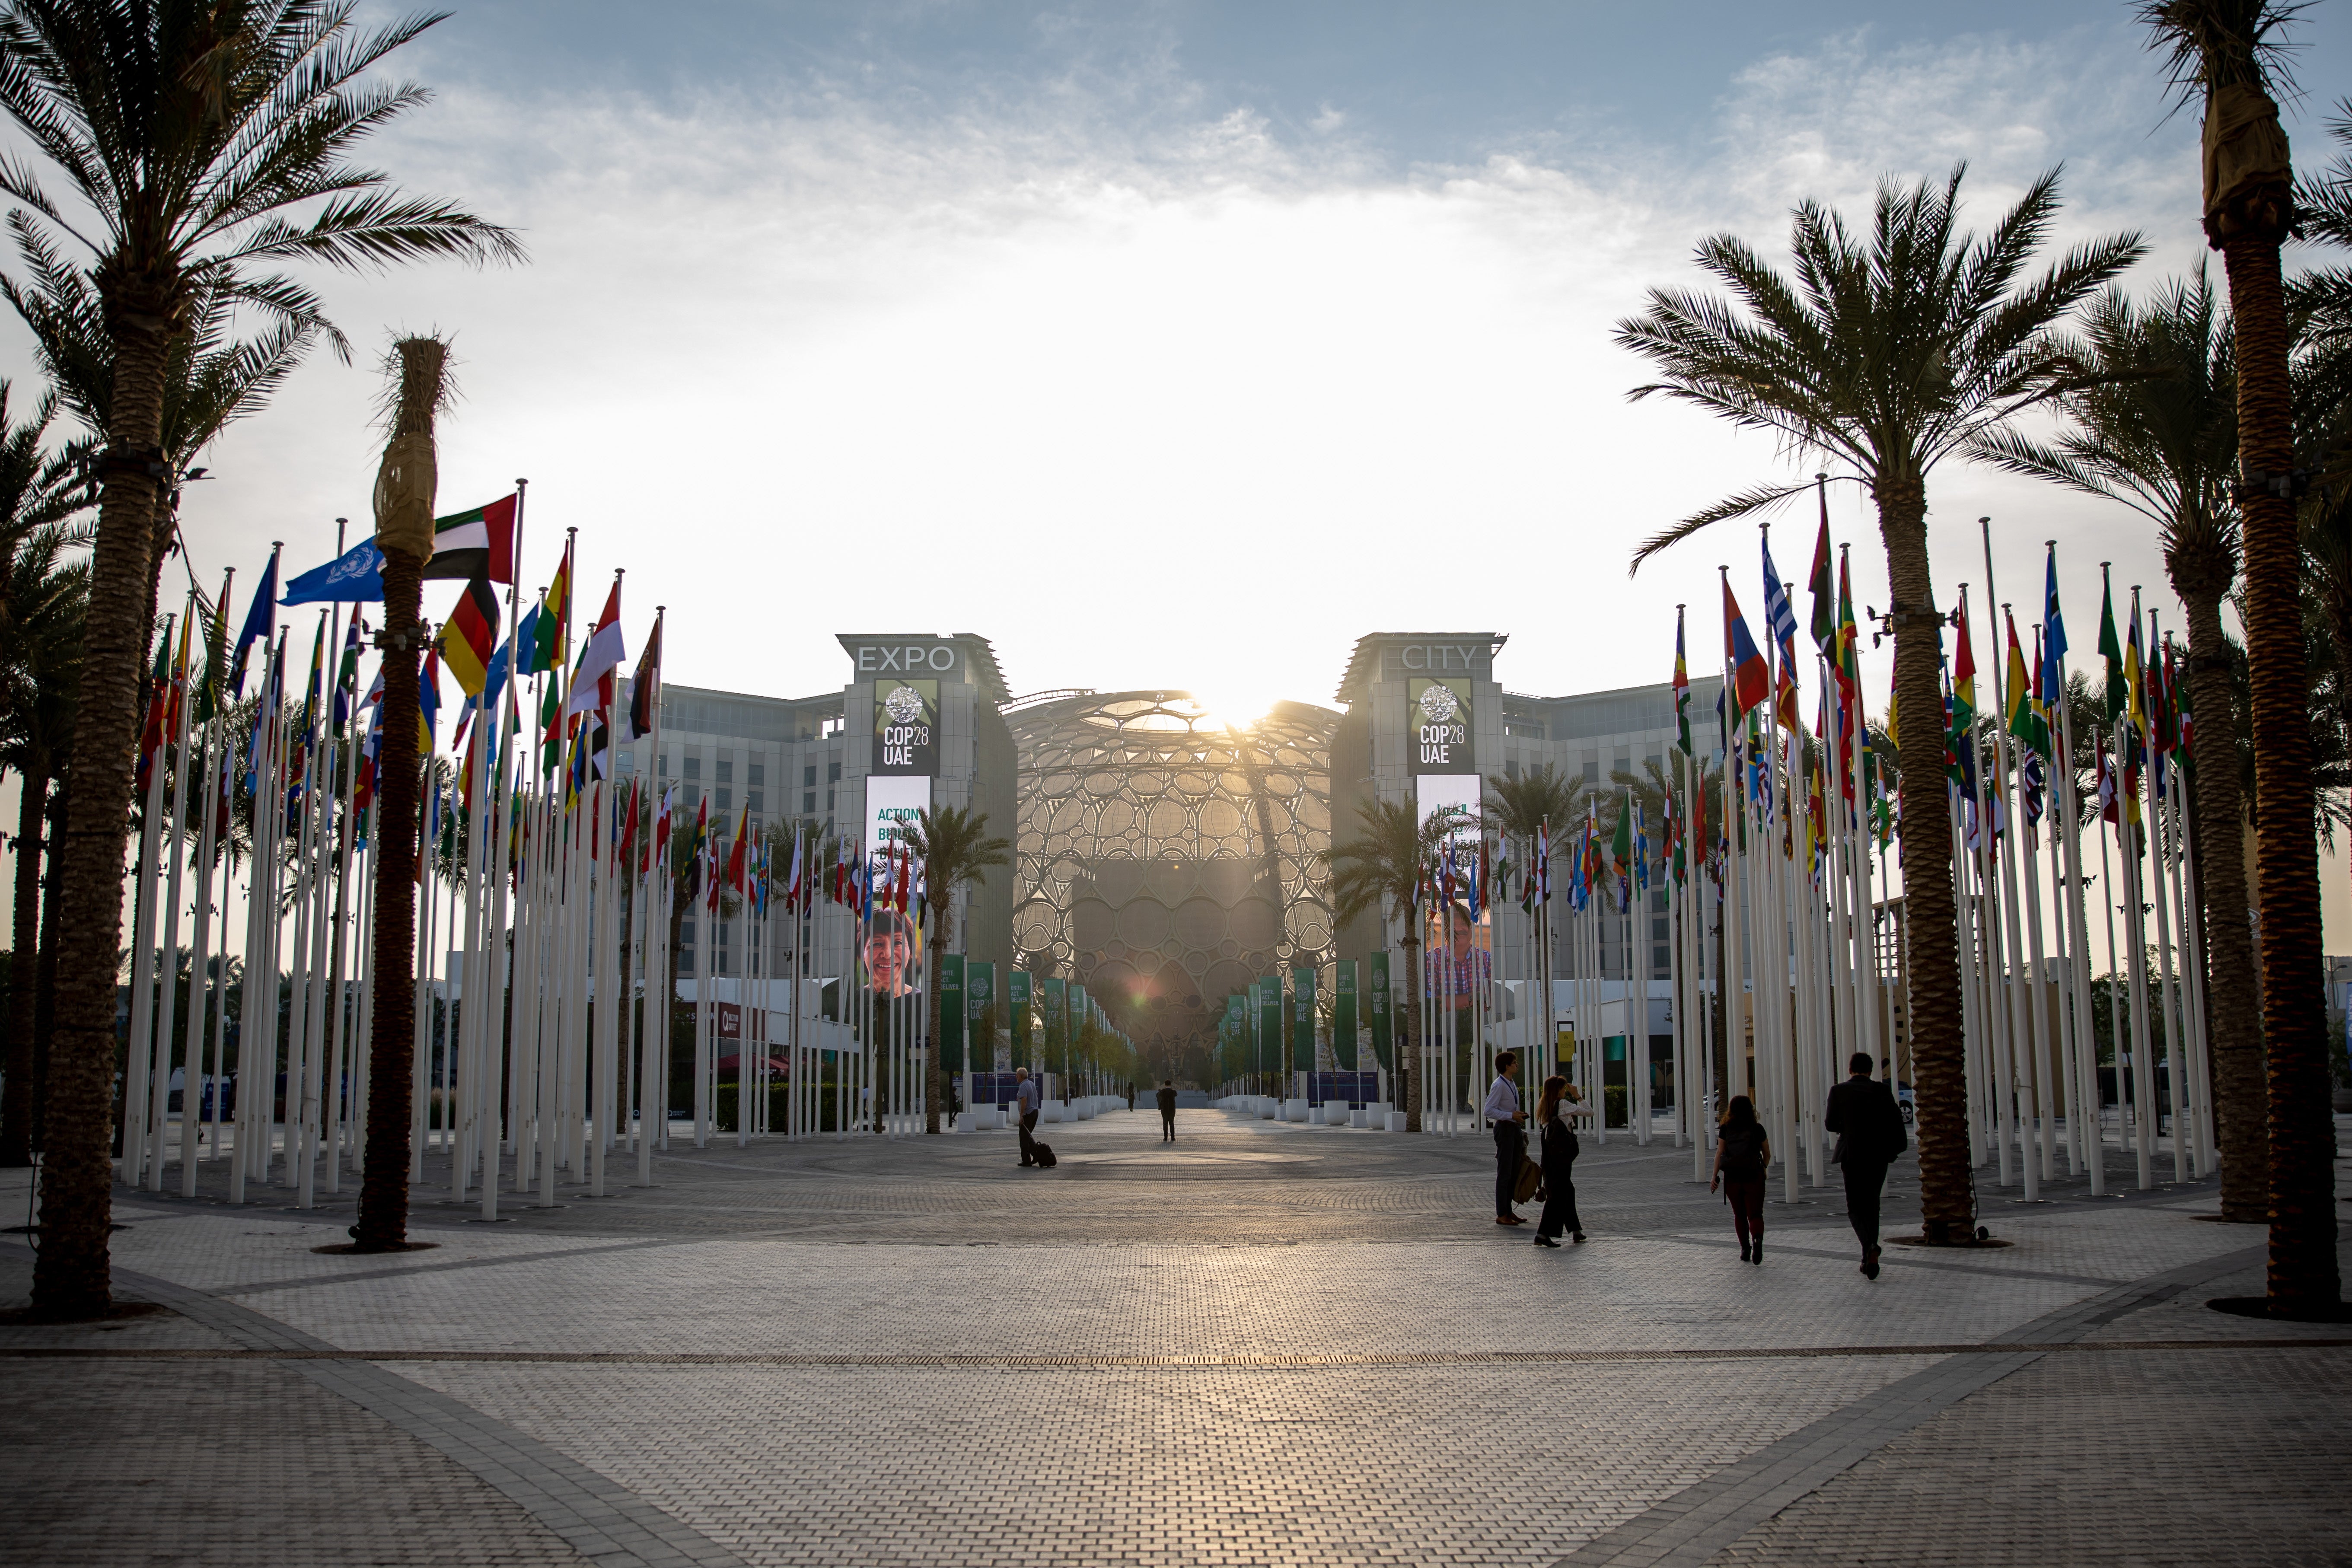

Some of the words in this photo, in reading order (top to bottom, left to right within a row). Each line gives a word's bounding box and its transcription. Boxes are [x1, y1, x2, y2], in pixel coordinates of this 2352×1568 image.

[859, 646, 955, 671] EXPO
[1402, 645, 1477, 669] CITY
[884, 726, 928, 746] COP28
[1420, 725, 1464, 744] COP28
[884, 746, 912, 765] UAE
[1420, 745, 1449, 764] UAE
[878, 808, 919, 821] ACTION
[970, 999, 992, 1009] COP28
[1373, 992, 1388, 1003] COP28
[1297, 1003, 1313, 1013] COP28
[1374, 1003, 1383, 1013] UAE
